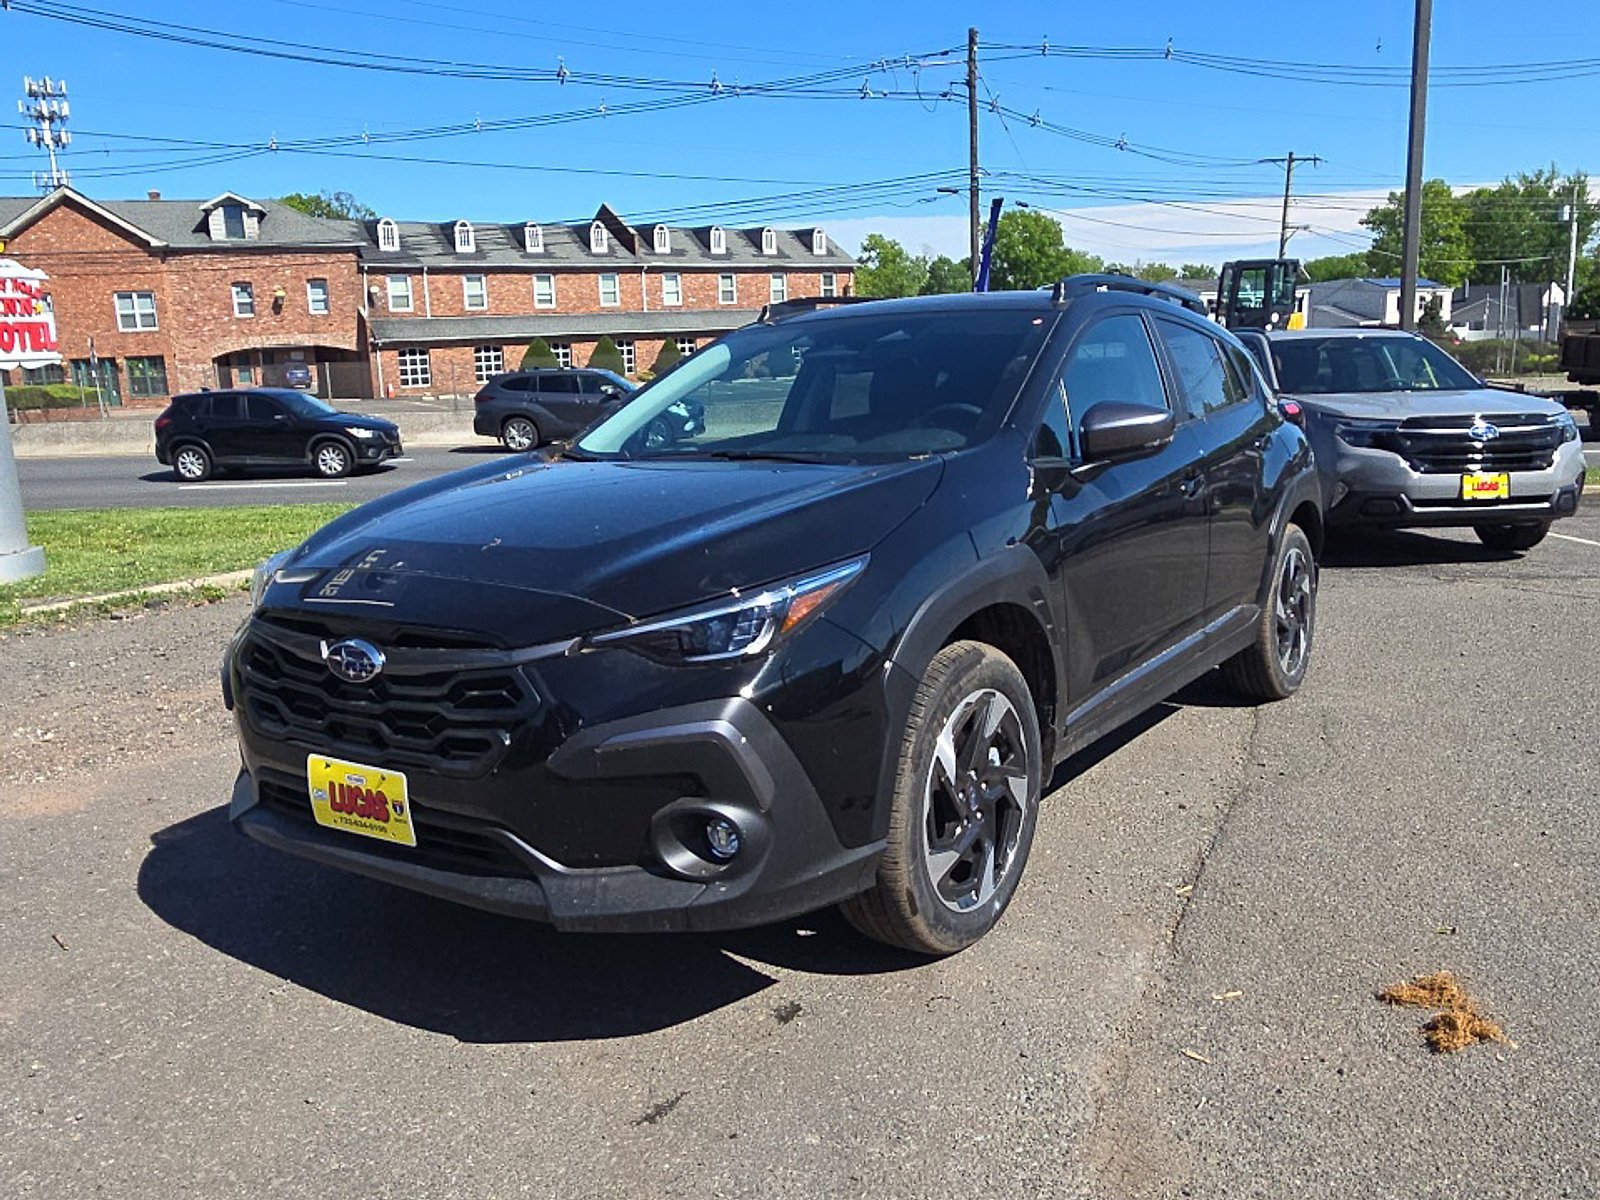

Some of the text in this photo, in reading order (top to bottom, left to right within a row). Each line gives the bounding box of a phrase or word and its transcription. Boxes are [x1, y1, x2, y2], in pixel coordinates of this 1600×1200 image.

[0, 297, 32, 317] NN
[0, 322, 57, 353] OTEL
[328, 780, 390, 824] LUCAS
